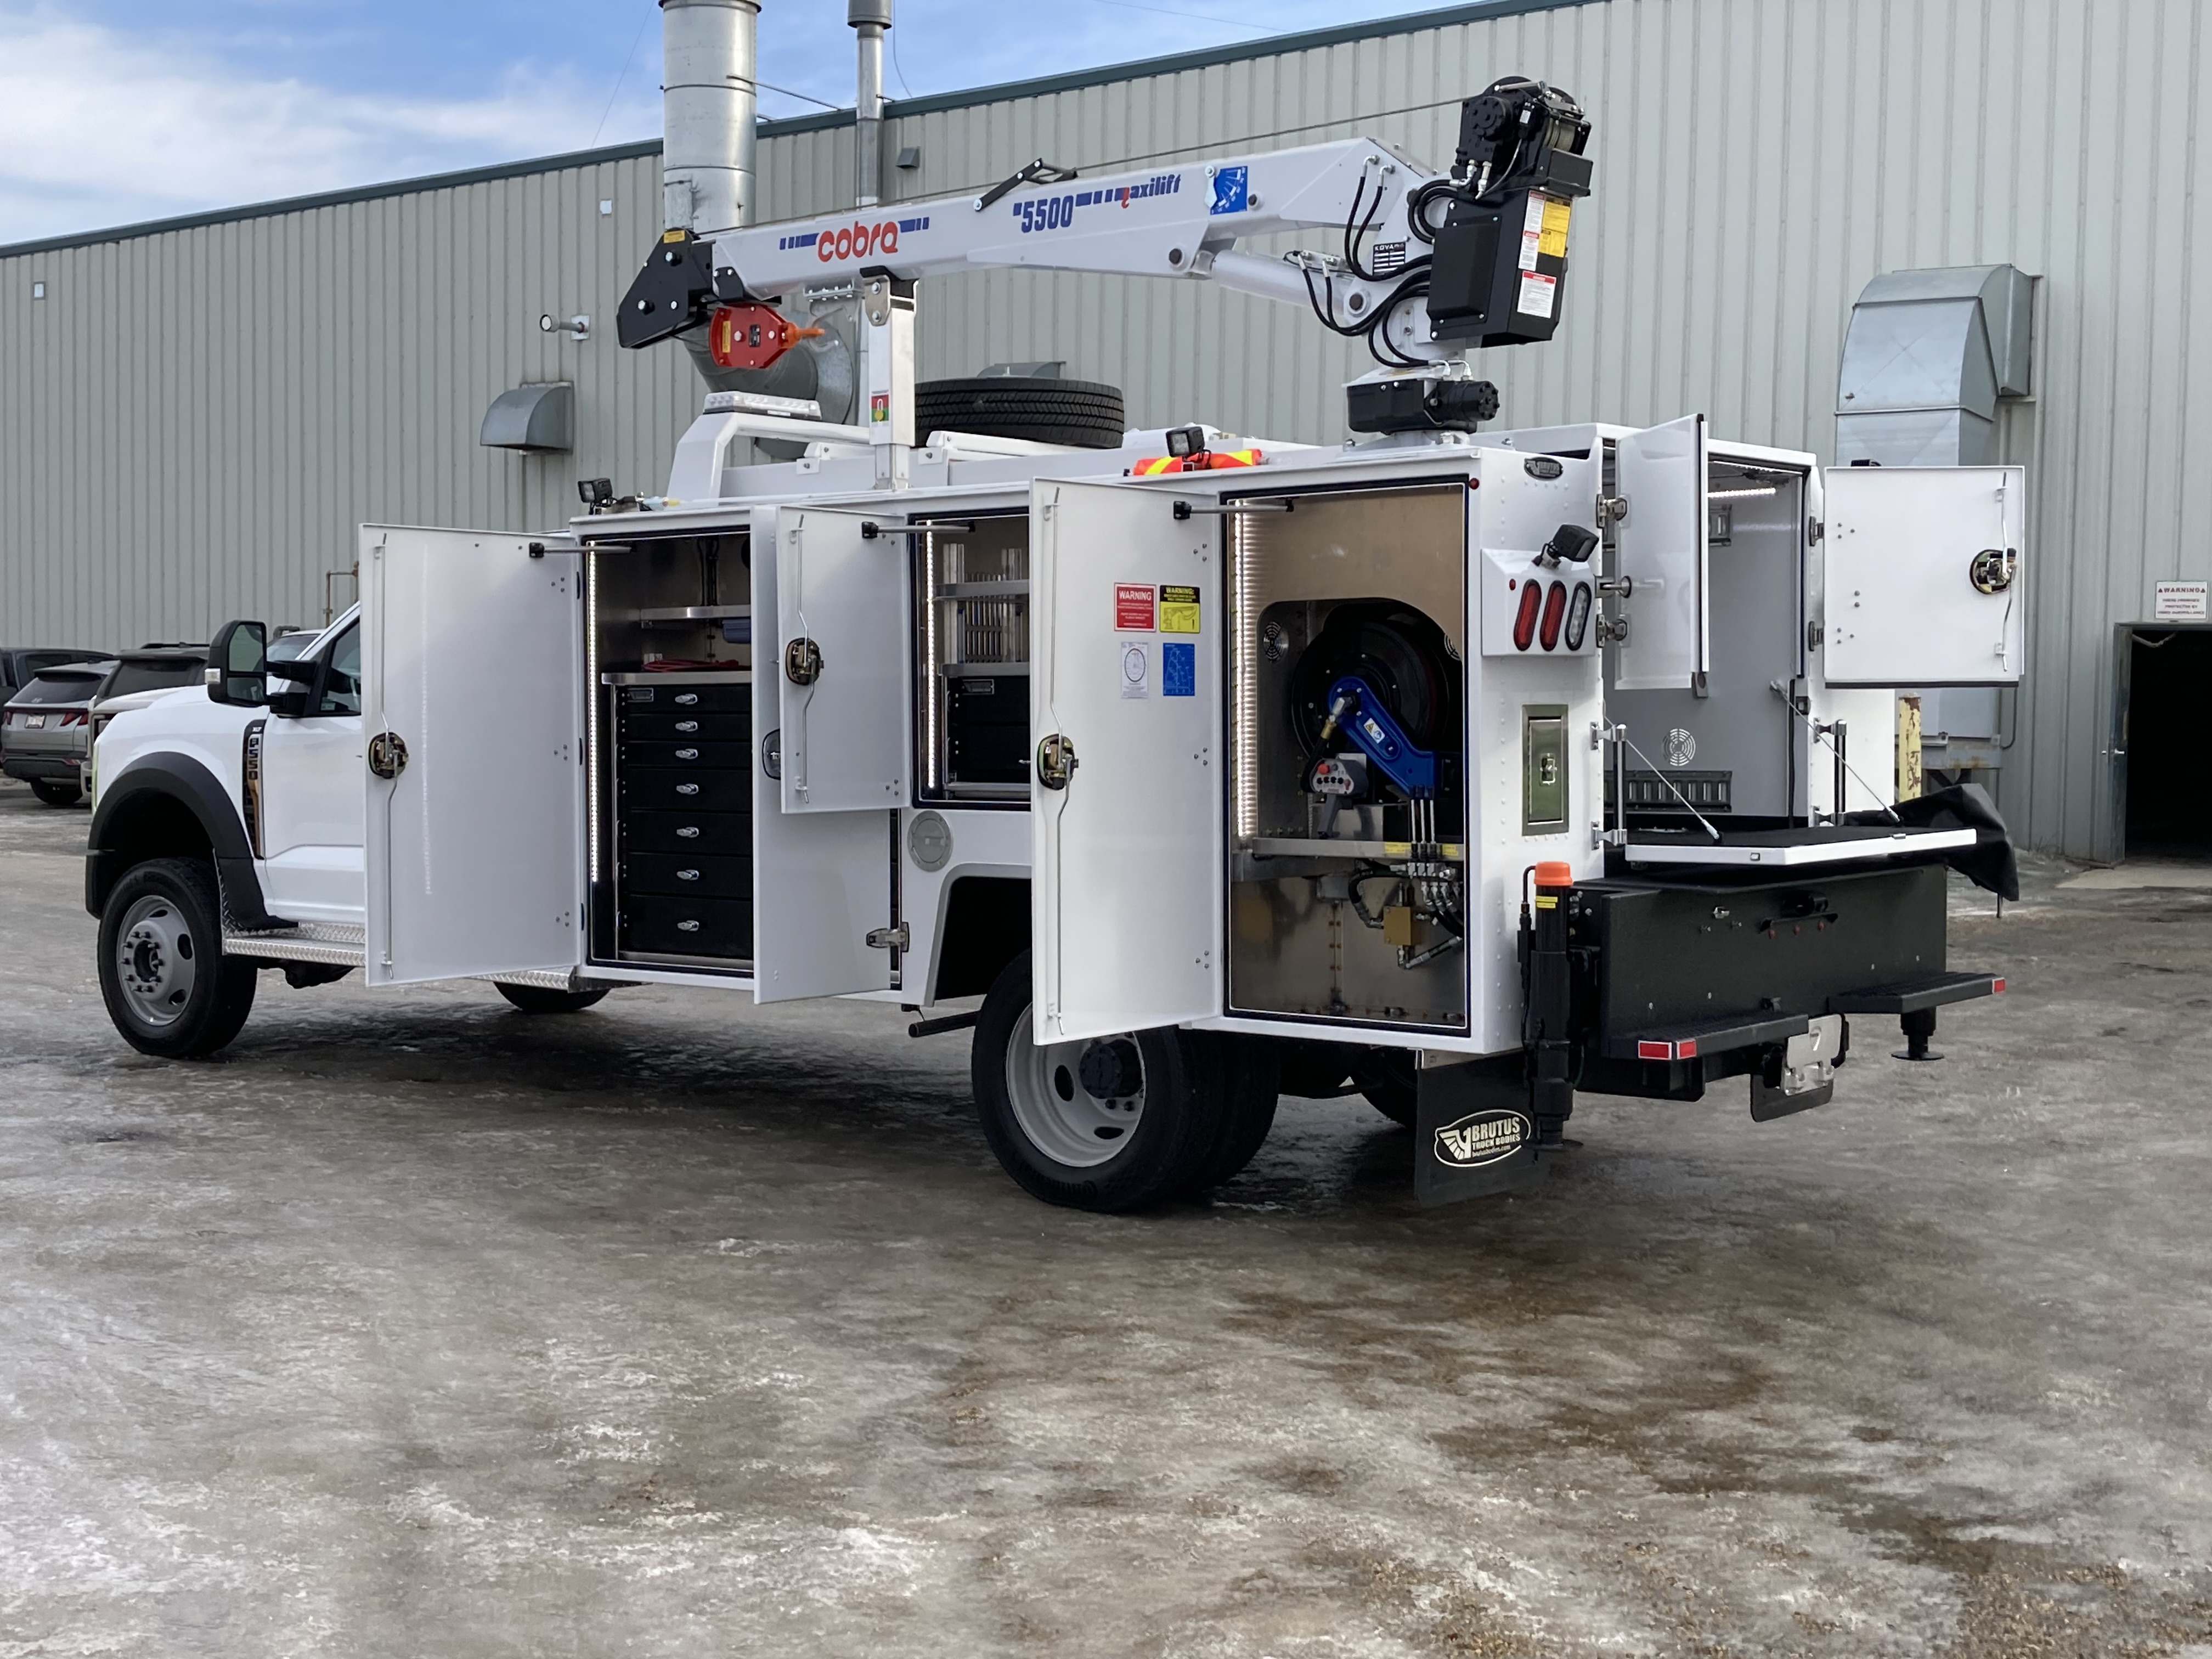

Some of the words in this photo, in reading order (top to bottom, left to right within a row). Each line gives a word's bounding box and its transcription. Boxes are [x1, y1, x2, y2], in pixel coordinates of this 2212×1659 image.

[1021, 195, 1074, 233] 5500
[817, 221, 899, 262] cobra
[1119, 590, 1152, 601] WARNING
[1472, 1116, 1520, 1142] BRUTUS
[1472, 1138, 1494, 1150] TRUCK
[1495, 1133, 1520, 1145] BODIES
